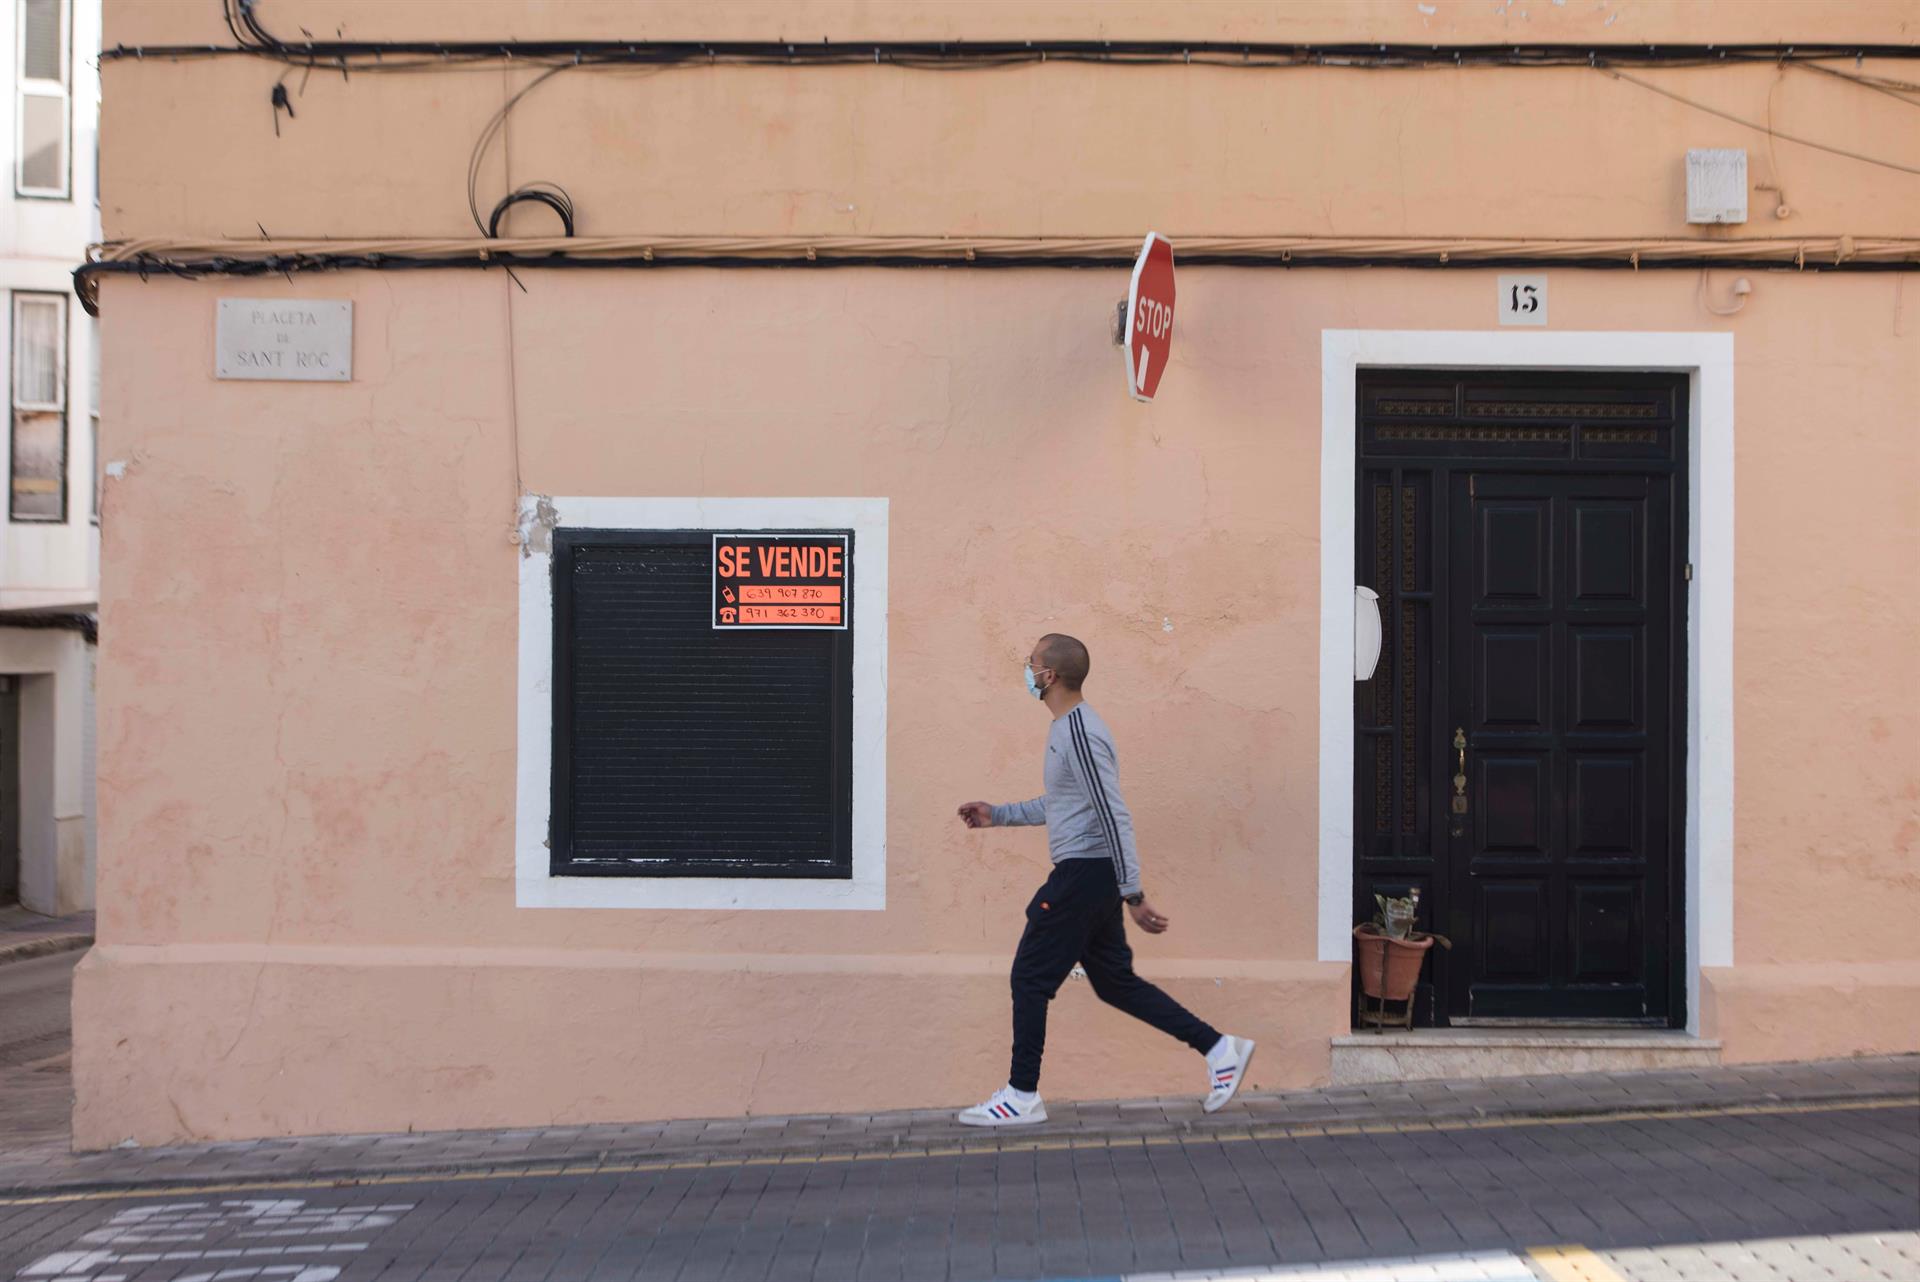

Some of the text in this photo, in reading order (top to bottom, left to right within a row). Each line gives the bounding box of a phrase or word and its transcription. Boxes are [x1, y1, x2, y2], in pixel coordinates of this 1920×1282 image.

[251, 310, 318, 326] PLACETA
[1136, 295, 1171, 340] STOP
[237, 351, 330, 368] SANT ROC
[718, 545, 842, 578] SE VENDE
[746, 588, 822, 599] 639 907 870
[746, 608, 768, 618] 971
